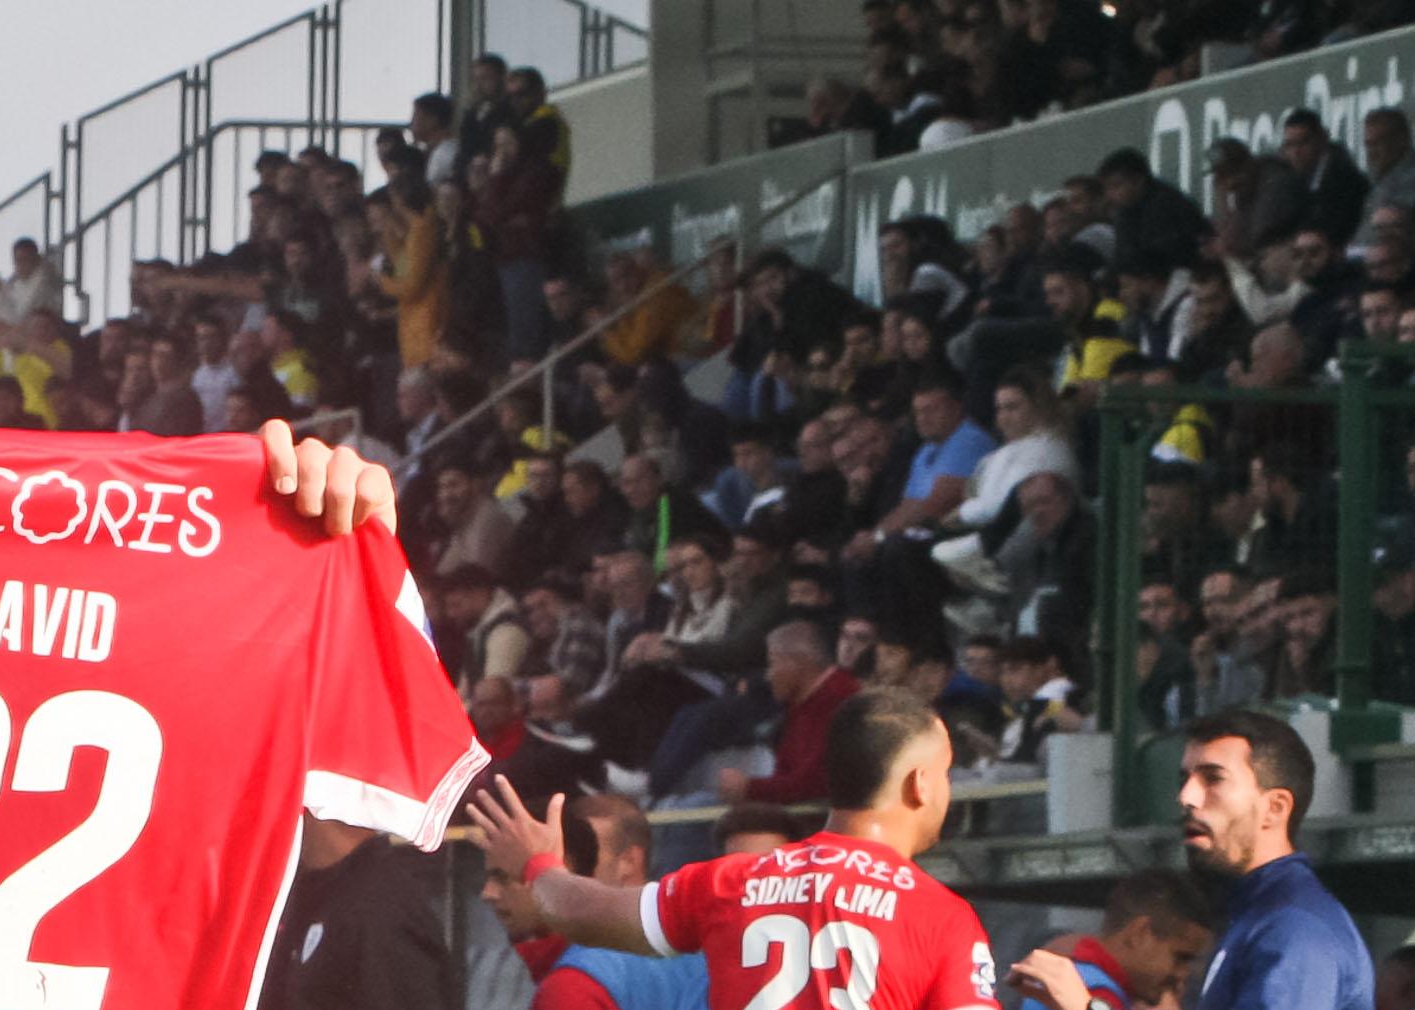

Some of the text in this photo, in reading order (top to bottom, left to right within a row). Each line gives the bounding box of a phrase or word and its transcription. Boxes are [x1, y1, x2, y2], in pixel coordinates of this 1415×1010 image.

[751, 844, 915, 890] AÇORES
[741, 873, 897, 921] SIDNEY LIMA
